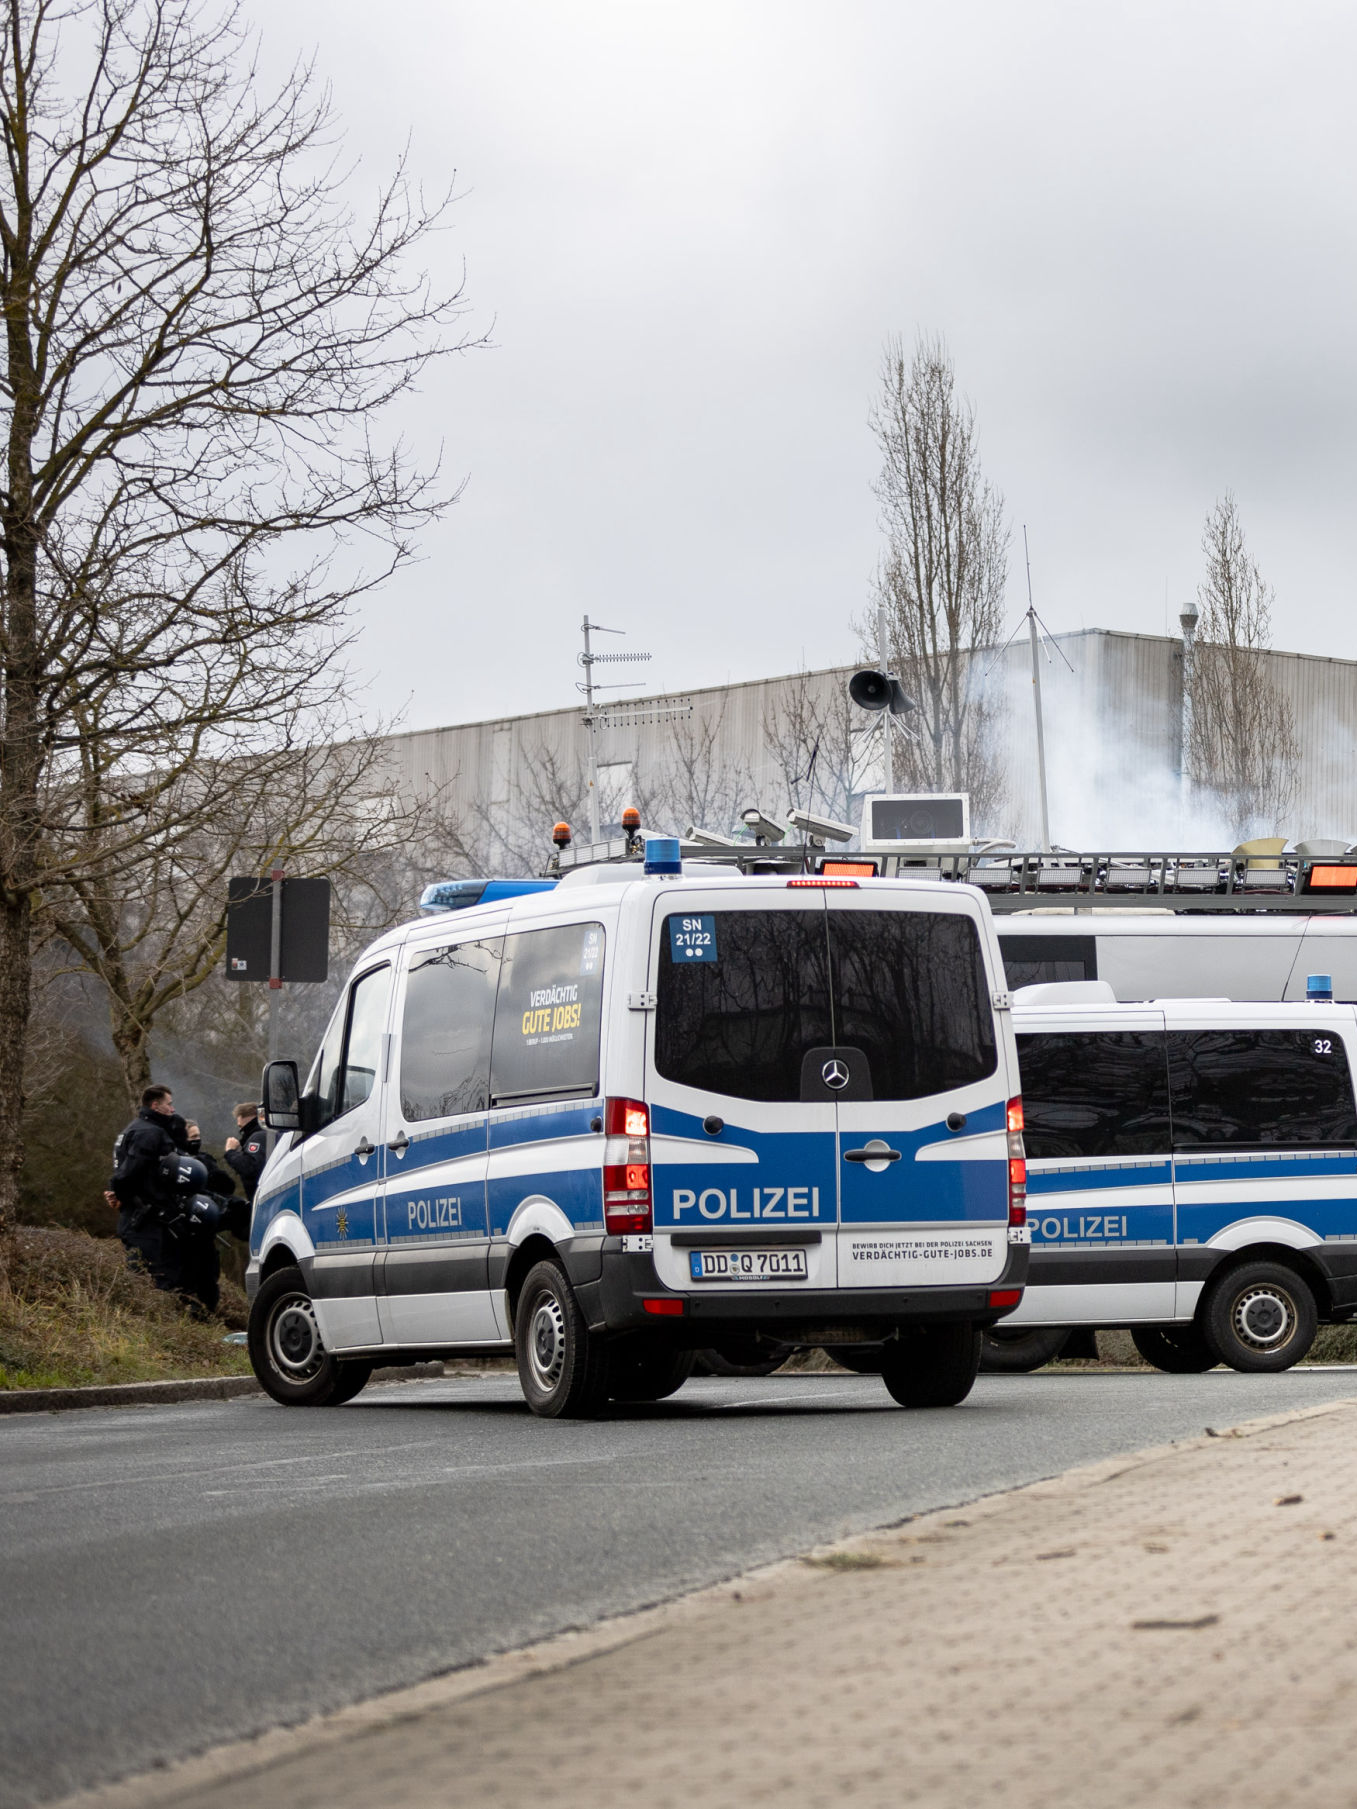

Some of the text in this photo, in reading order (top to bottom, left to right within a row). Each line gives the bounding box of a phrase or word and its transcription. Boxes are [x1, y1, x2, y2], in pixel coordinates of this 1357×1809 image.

[682, 919, 702, 931] SN
[675, 932, 711, 946] 21/22
[530, 984, 578, 1008] VERDÄCHTIG
[522, 1003, 582, 1035] GUTE JOBS!
[1314, 1039, 1332, 1054] 32
[408, 1197, 462, 1230] POLIZEI
[673, 1187, 819, 1220] POLIZEI
[852, 1242, 878, 1250] BEWIRB
[703, 1253, 804, 1274] DD Q 7011
